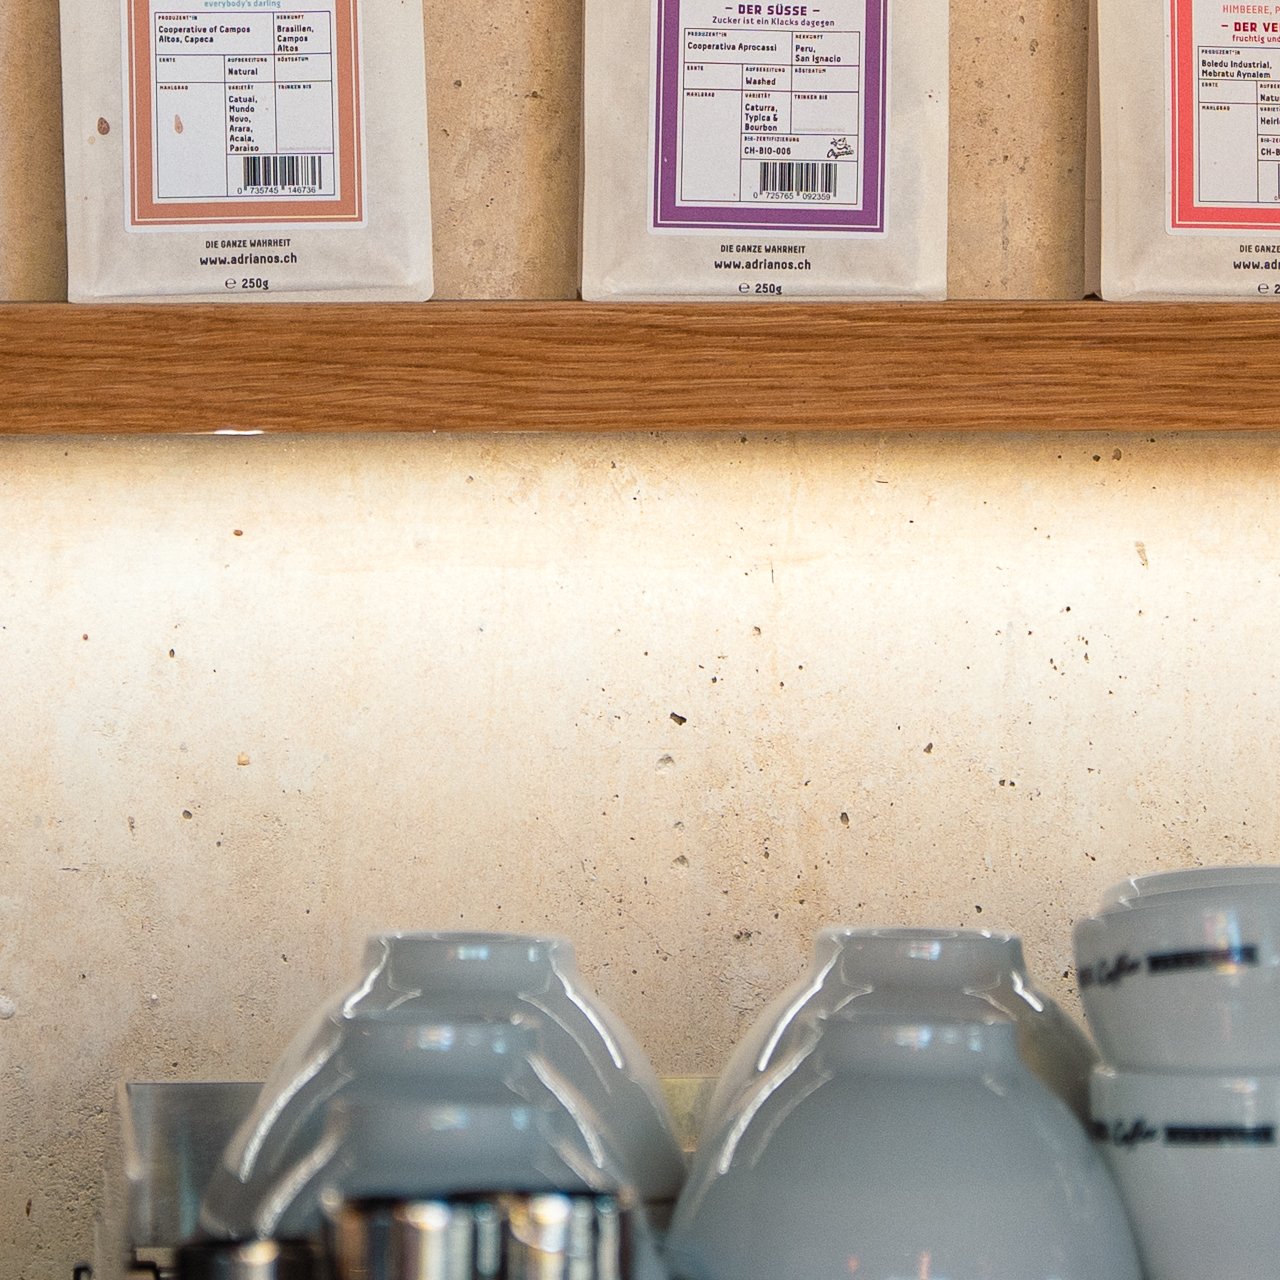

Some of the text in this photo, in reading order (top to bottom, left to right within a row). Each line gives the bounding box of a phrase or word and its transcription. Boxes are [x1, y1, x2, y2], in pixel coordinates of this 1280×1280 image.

[204, 0, 281, 8] everybody's darling
[738, 4, 807, 15] DER SÜSSE
[1223, 5, 1272, 15] HIMBEERE,
[1234, 22, 1257, 32] DER
[688, 42, 777, 52] Cooperativa Aprocassi
[1202, 60, 1272, 69] Boledu Industrial,
[1202, 70, 1270, 79] Mebratu Aynalem
[250, 186, 278, 194] 735745
[766, 192, 794, 200] 725765
[221, 240, 247, 248] GANZE
[250, 239, 291, 247] WAHRHEIT
[720, 244, 806, 253] DIE GANZE WAHRHEIT
[1239, 245, 1252, 253] DIE
[1255, 245, 1280, 253] GANZE
[200, 252, 297, 265] www.adrianos.ch
[715, 258, 811, 270] www.adrianos.ch
[242, 278, 269, 290] 250g
[755, 283, 782, 295] 250g
